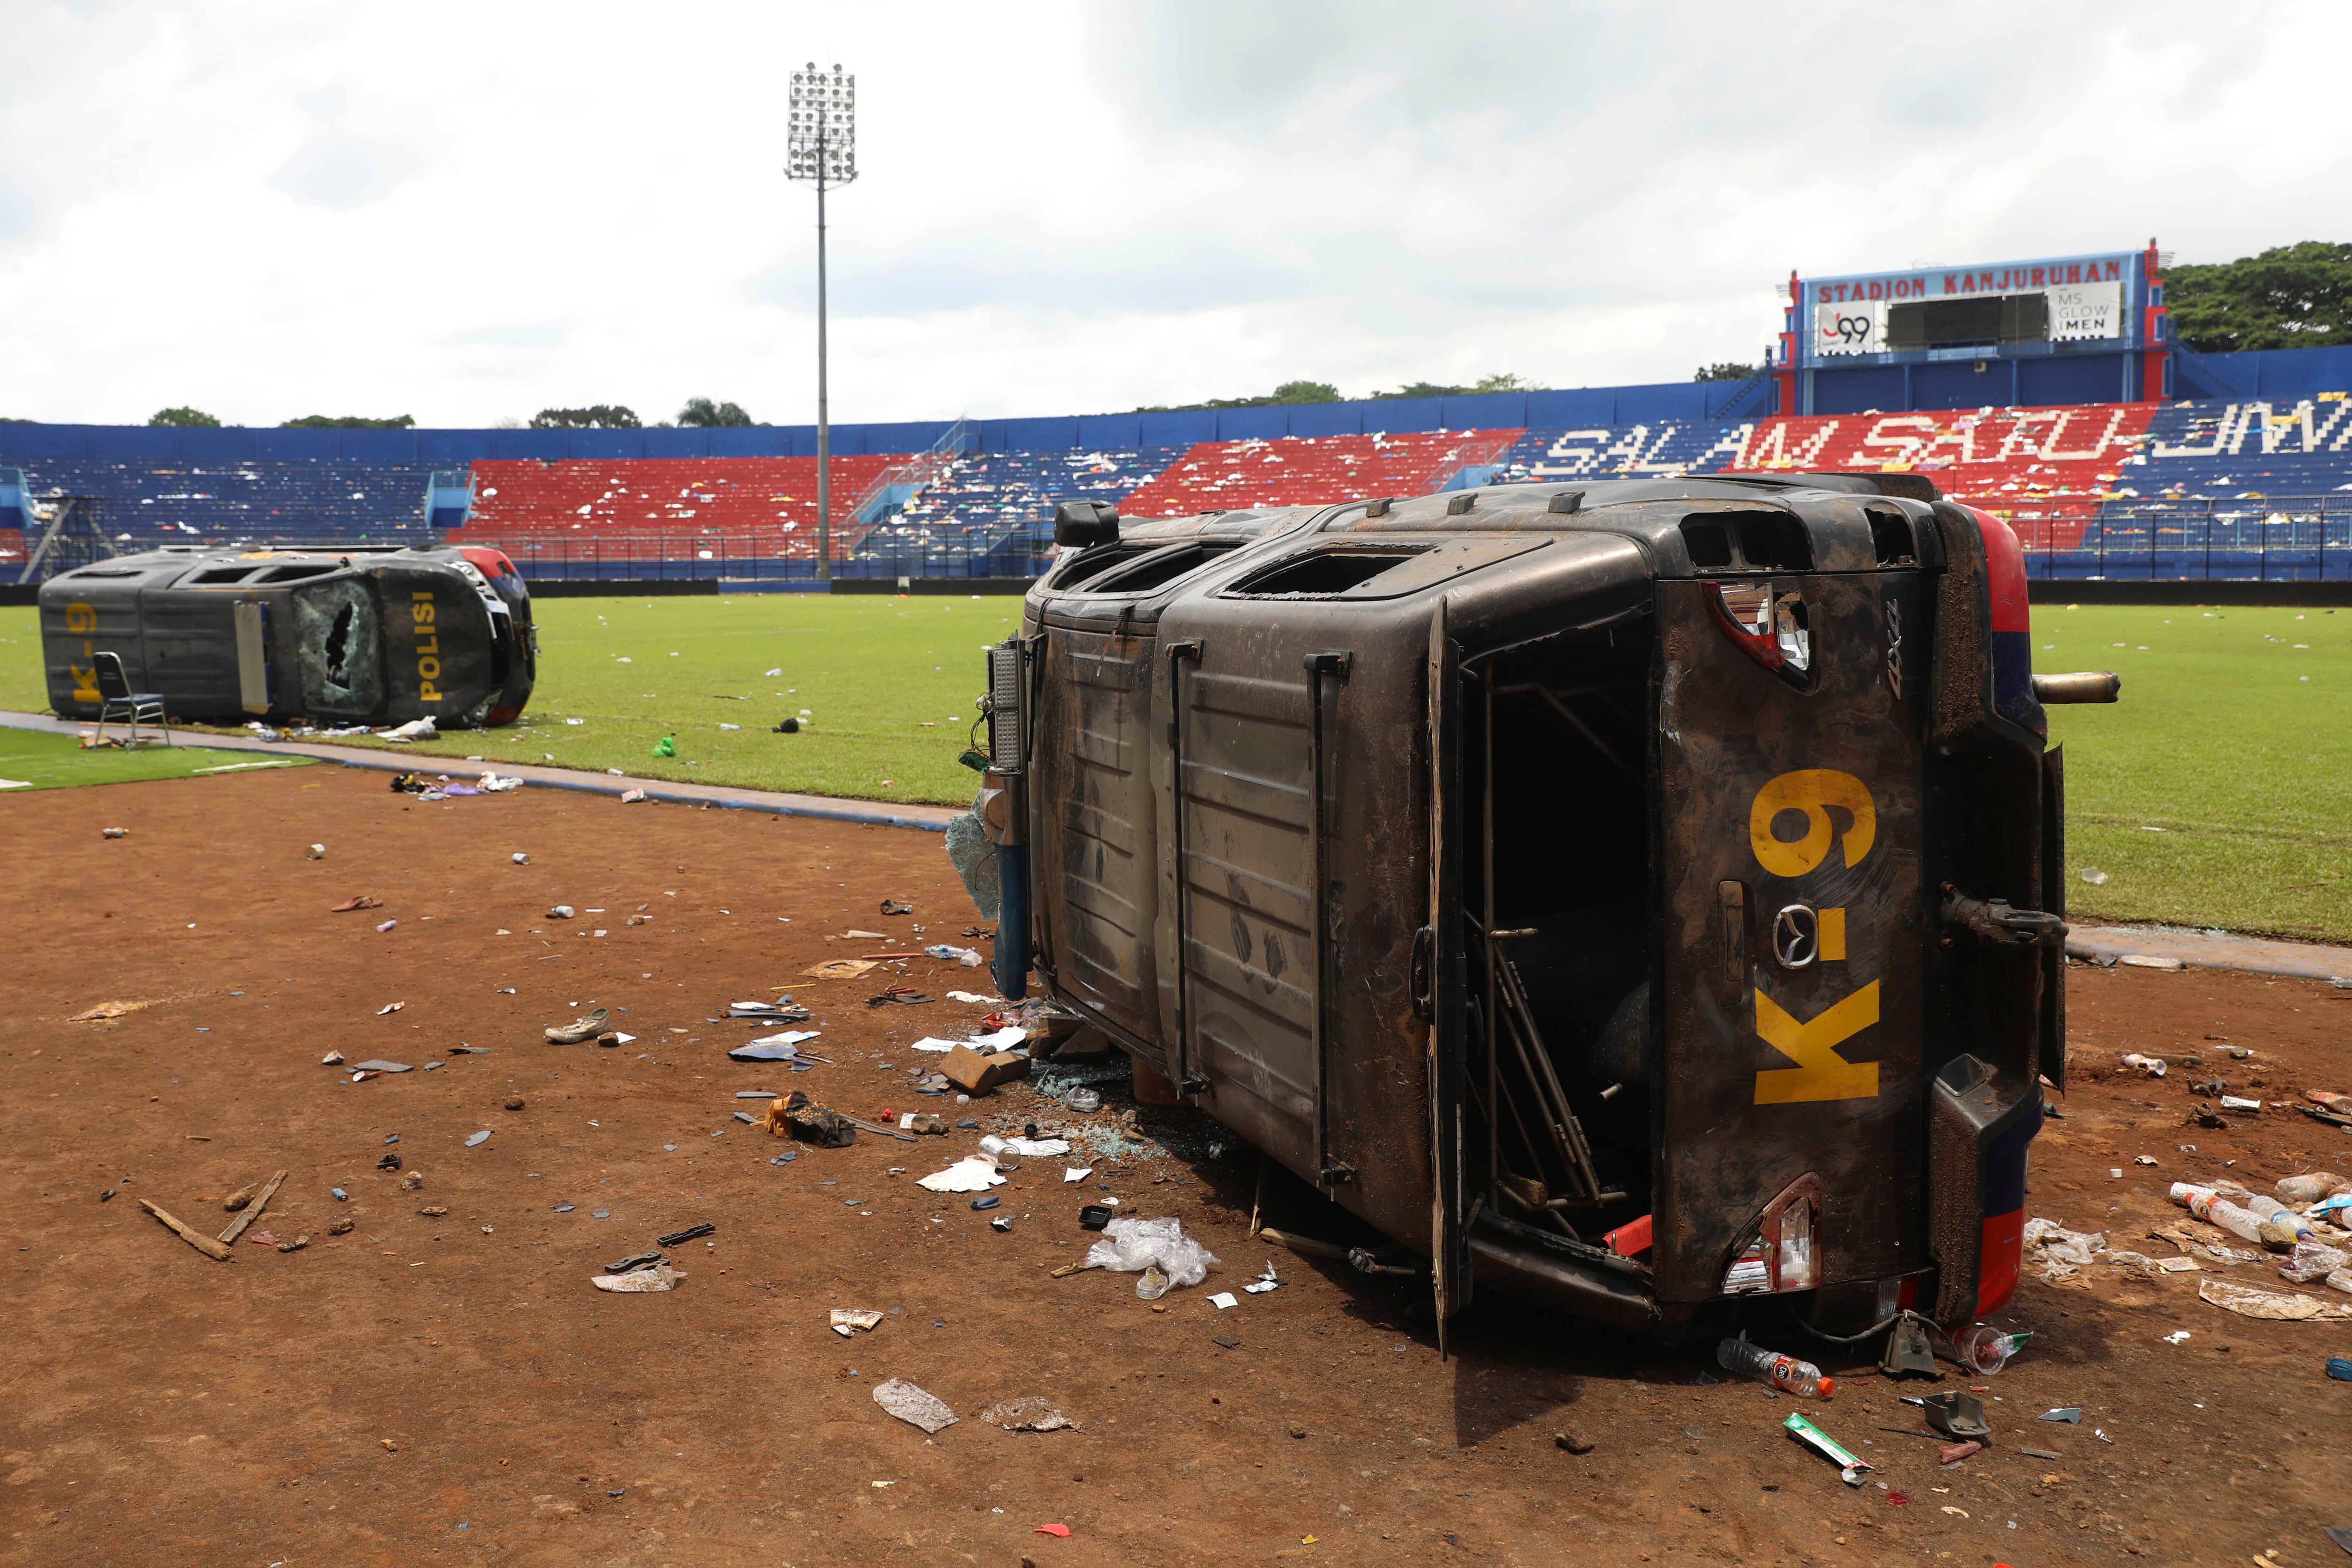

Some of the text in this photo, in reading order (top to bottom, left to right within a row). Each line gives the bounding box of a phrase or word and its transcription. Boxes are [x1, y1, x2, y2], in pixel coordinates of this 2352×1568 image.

[1819, 262, 2120, 302] STADION KANJURUHAN
[2058, 293, 2082, 305] MS
[2058, 304, 2108, 318] GLOW
[2067, 319, 2105, 330] MEN
[2152, 398, 2352, 457] JIW
[65, 602, 102, 702] K-9
[412, 592, 443, 700] POLISI
[1750, 769, 1879, 1105] K-9
[1778, 1367, 1787, 1378] Cleo
